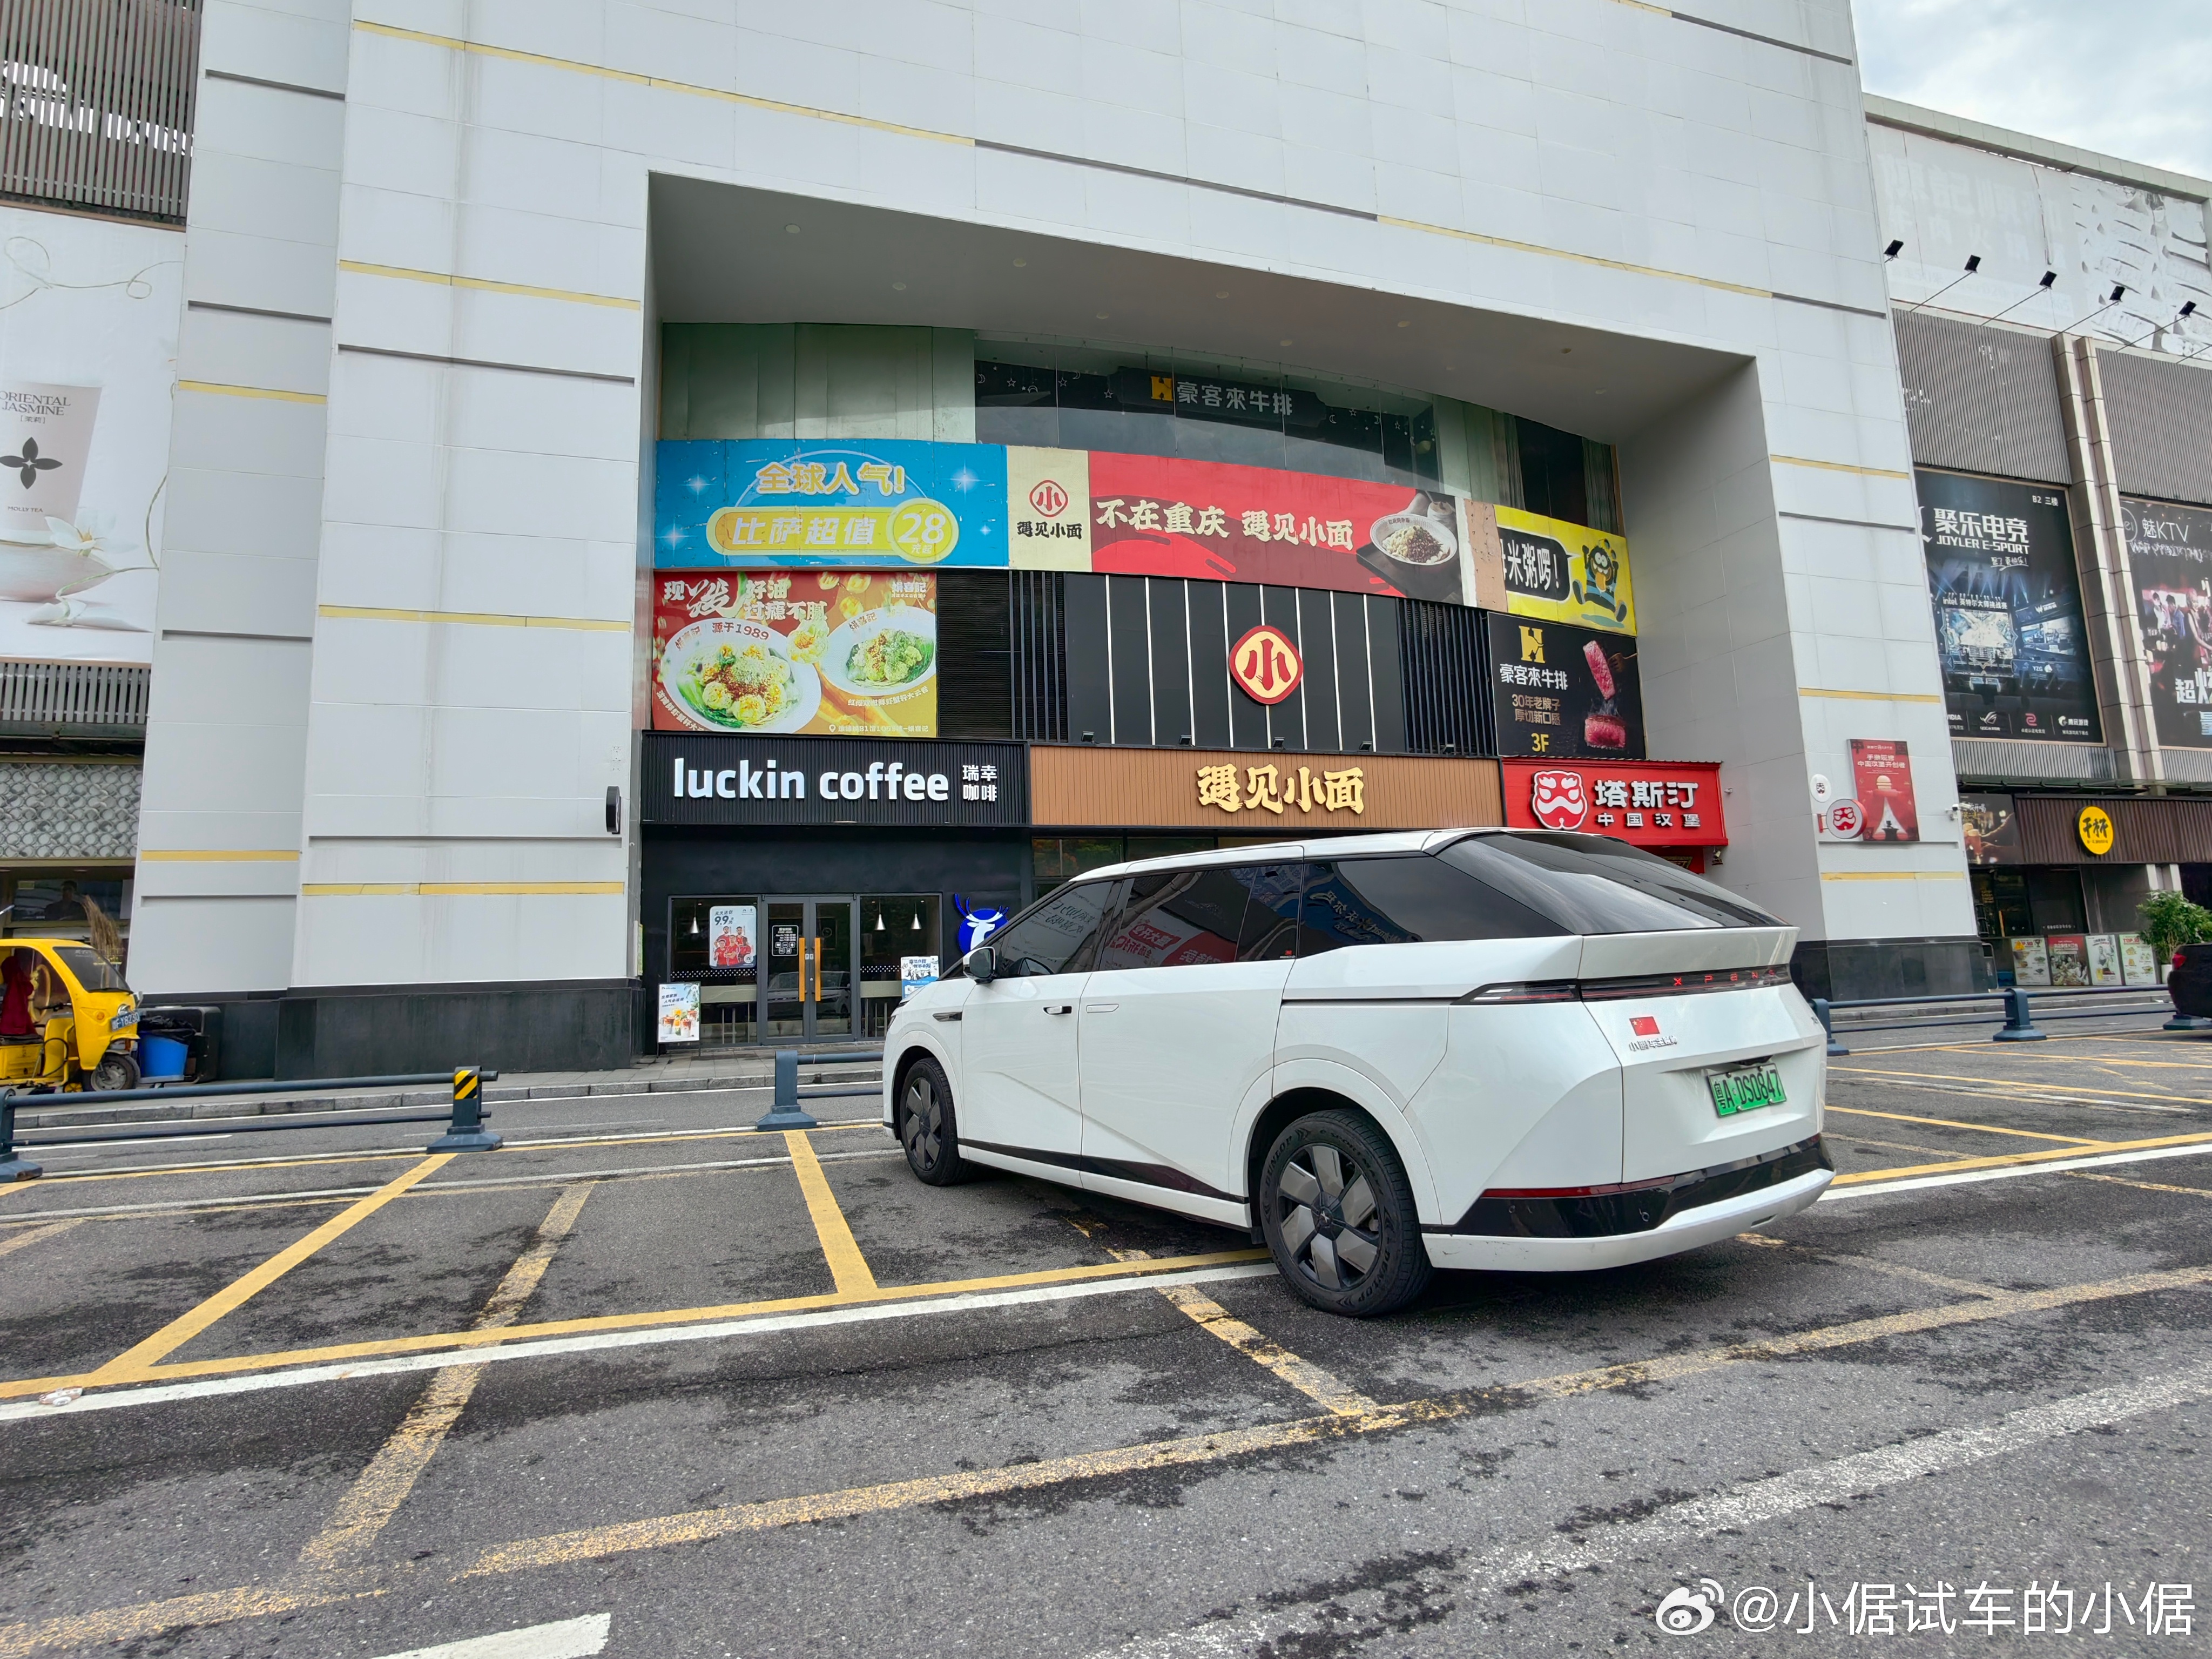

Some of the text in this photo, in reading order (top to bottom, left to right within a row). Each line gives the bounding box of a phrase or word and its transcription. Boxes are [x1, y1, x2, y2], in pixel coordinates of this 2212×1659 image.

[0, 391, 71, 406] ORIENTAL
[2, 401, 64, 415] JASMINE
[1177, 381, 1293, 415] 豪客來牛排
[757, 462, 905, 496] 全球人气!
[1036, 486, 1062, 511] 小
[2032, 495, 2041, 503] B2
[732, 512, 946, 545] 比萨超值 28
[1017, 521, 1082, 539] 遇见小面
[1095, 498, 1353, 550] 不在重庆 遇见小面
[1933, 508, 2029, 543] 聚乐电竞
[2142, 517, 2189, 542] 魅KTV
[1937, 535, 2030, 554] JOYLER E-SPORT
[1500, 538, 1560, 591] 米粥啰!
[1943, 597, 2008, 609] intel 英特尔大师挑战赛
[712, 622, 770, 640] 源于1989
[1243, 638, 1291, 691] 小
[1500, 664, 1568, 691] 豪客來牛排
[1512, 694, 1561, 711] 30年老牌子
[1531, 732, 1550, 752] 3F
[673, 758, 949, 801] luckin coffee
[962, 764, 997, 781] 瑞幸
[963, 783, 997, 802] 咖啡
[1196, 763, 1364, 814] 遇见小面
[1594, 779, 1698, 808] 塔斯汀
[1597, 812, 1701, 827] 中国汉堡
